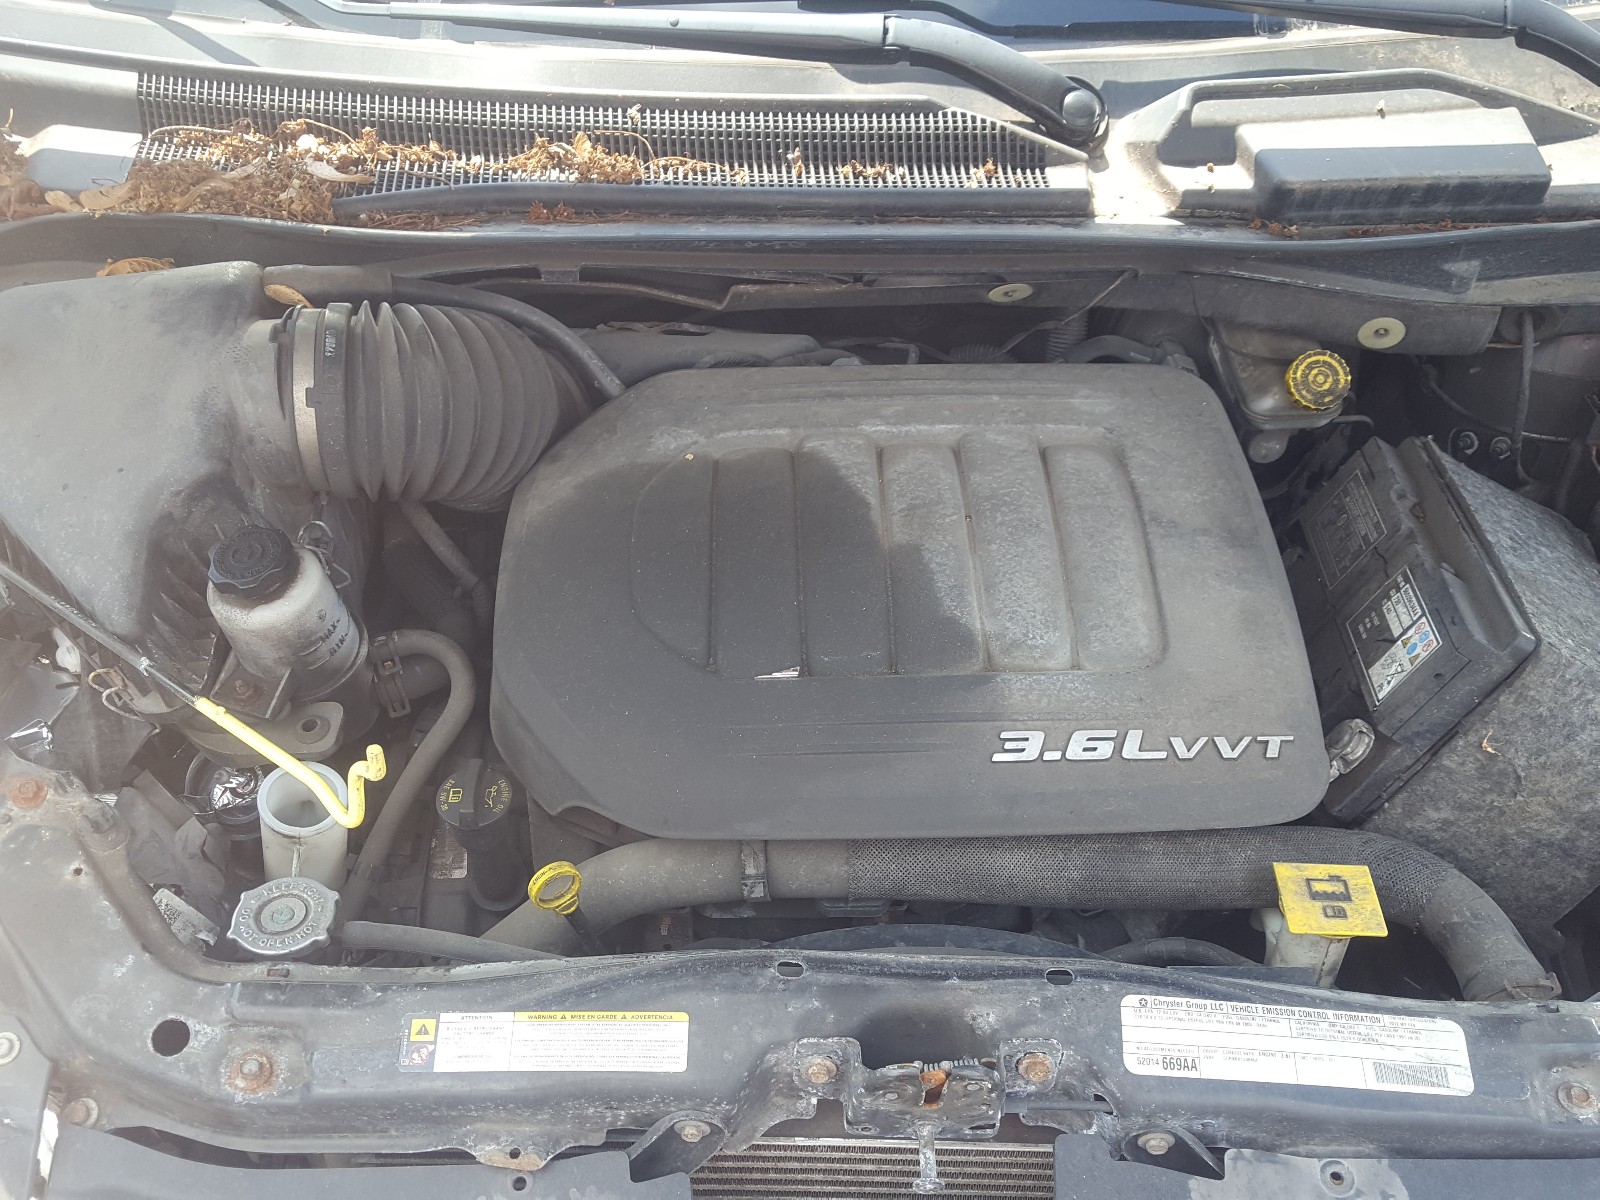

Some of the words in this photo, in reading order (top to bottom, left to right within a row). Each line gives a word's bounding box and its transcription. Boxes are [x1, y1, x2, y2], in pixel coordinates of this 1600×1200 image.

[493, 804, 504, 813] OIL
[258, 937, 294, 947] OPEN
[1153, 998, 1183, 1009] Chrysler
[1185, 1000, 1208, 1011] Group
[1210, 1002, 1224, 1012] LLC
[1230, 1004, 1259, 1014] VEHICLE
[1262, 1006, 1296, 1018] EMISSION
[1298, 1010, 1331, 1020] CONTROL
[1332, 1012, 1381, 1024] INFORMATION
[1136, 1056, 1160, 1067] 52014
[1162, 1056, 1198, 1072] 669AA
